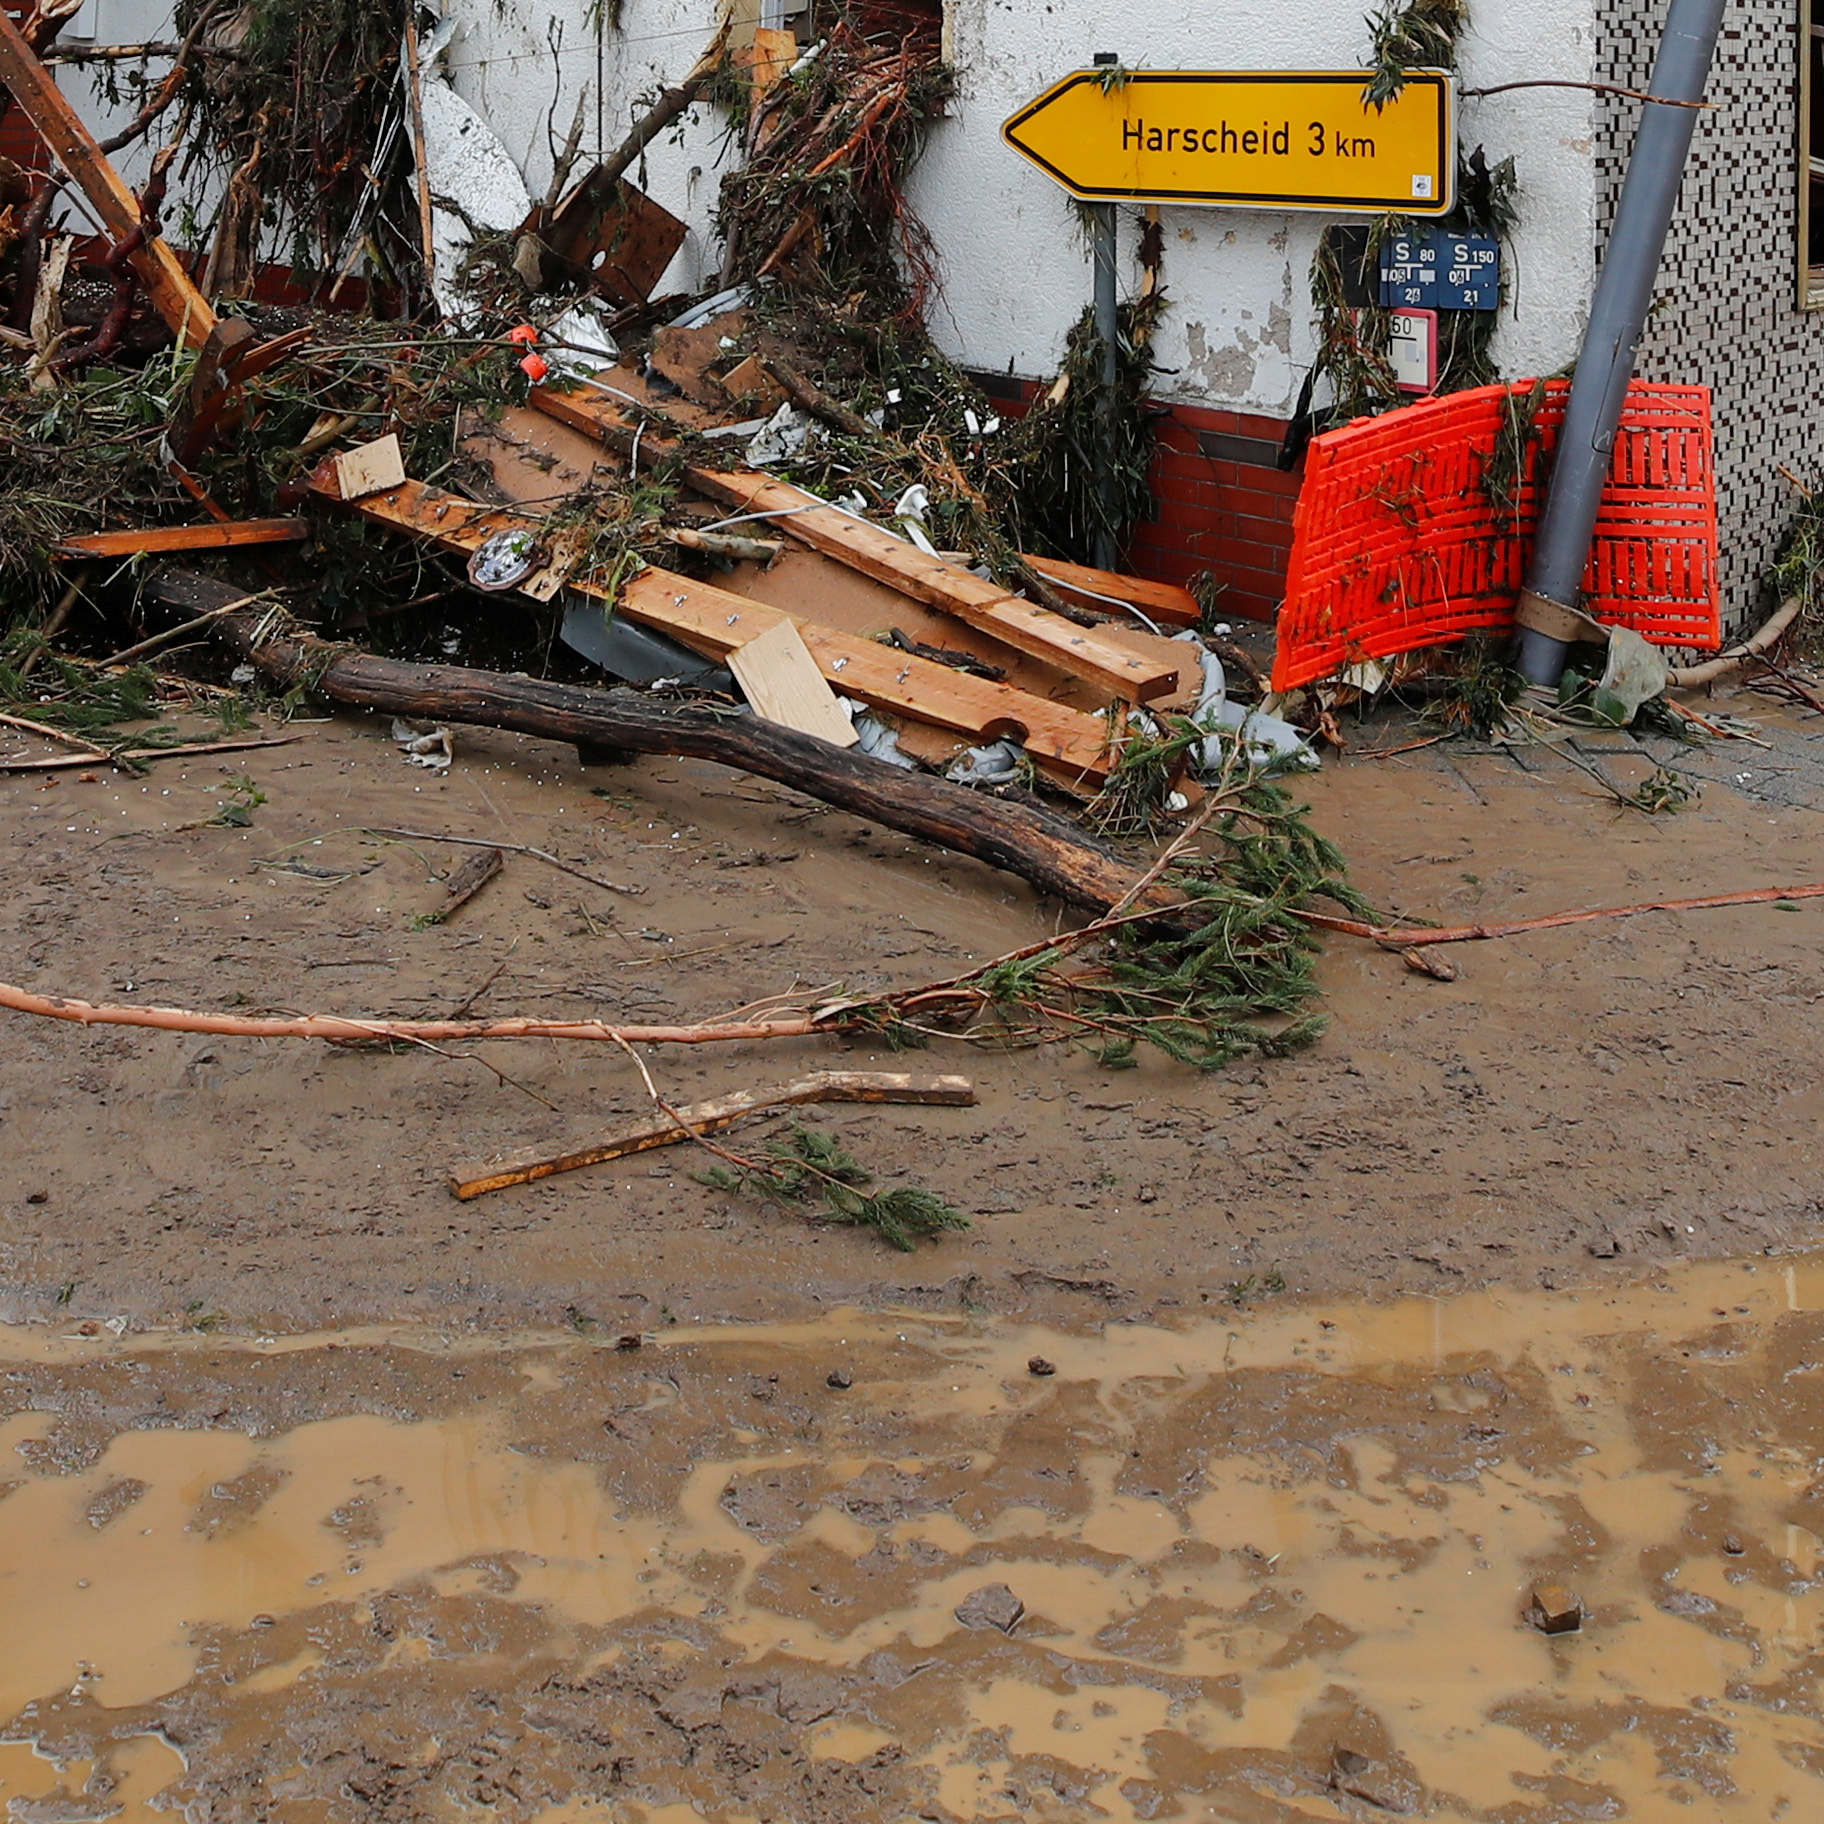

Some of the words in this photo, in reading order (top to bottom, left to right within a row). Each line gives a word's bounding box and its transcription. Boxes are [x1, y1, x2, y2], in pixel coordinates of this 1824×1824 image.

[1122, 118, 1289, 155] Harscheid
[1307, 121, 1325, 156] 3
[1336, 131, 1375, 157] km
[1395, 242, 1410, 261] S
[1419, 248, 1435, 262] 80
[1454, 243, 1469, 262] S
[1472, 250, 1494, 264] 150
